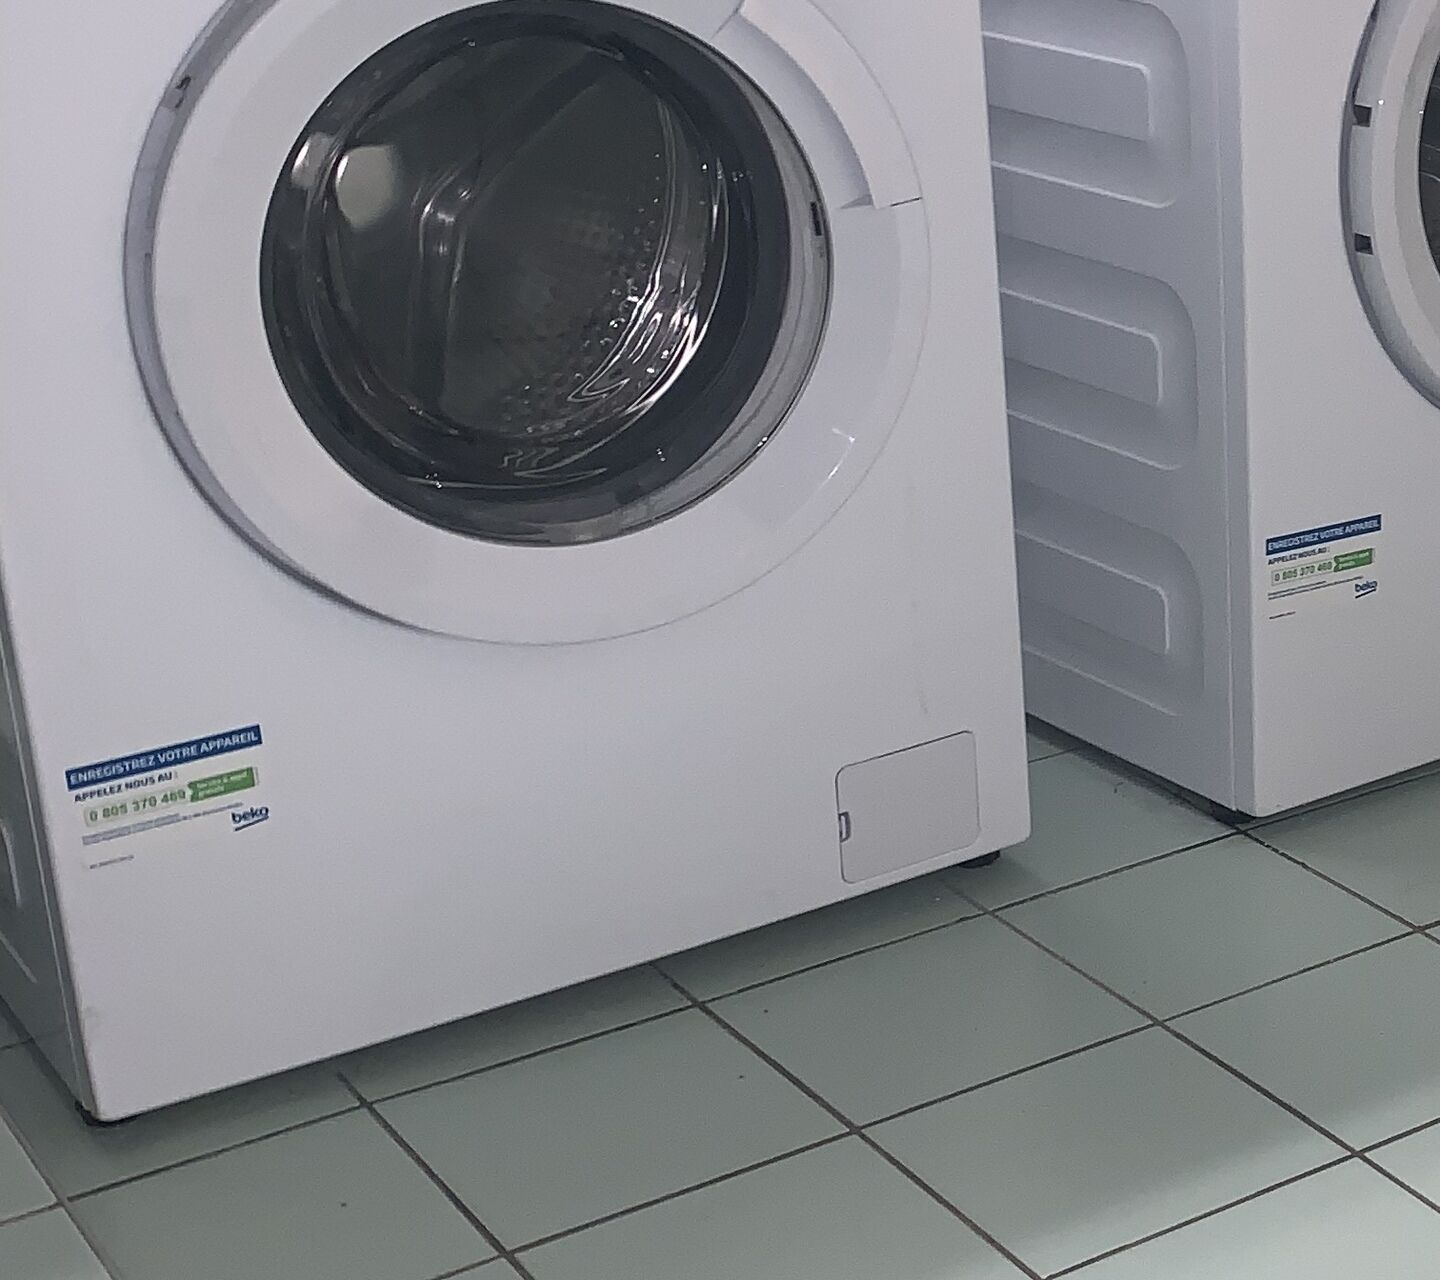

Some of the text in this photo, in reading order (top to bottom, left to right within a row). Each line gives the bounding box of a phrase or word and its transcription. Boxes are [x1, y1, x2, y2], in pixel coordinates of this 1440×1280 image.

[69, 731, 259, 785] ENREGISTREZ VOTRE APPAREIL
[74, 784, 122, 802] APPELEZ
[124, 777, 155, 790] NOUS
[89, 810, 98, 822] 0
[231, 806, 269, 824] beko
